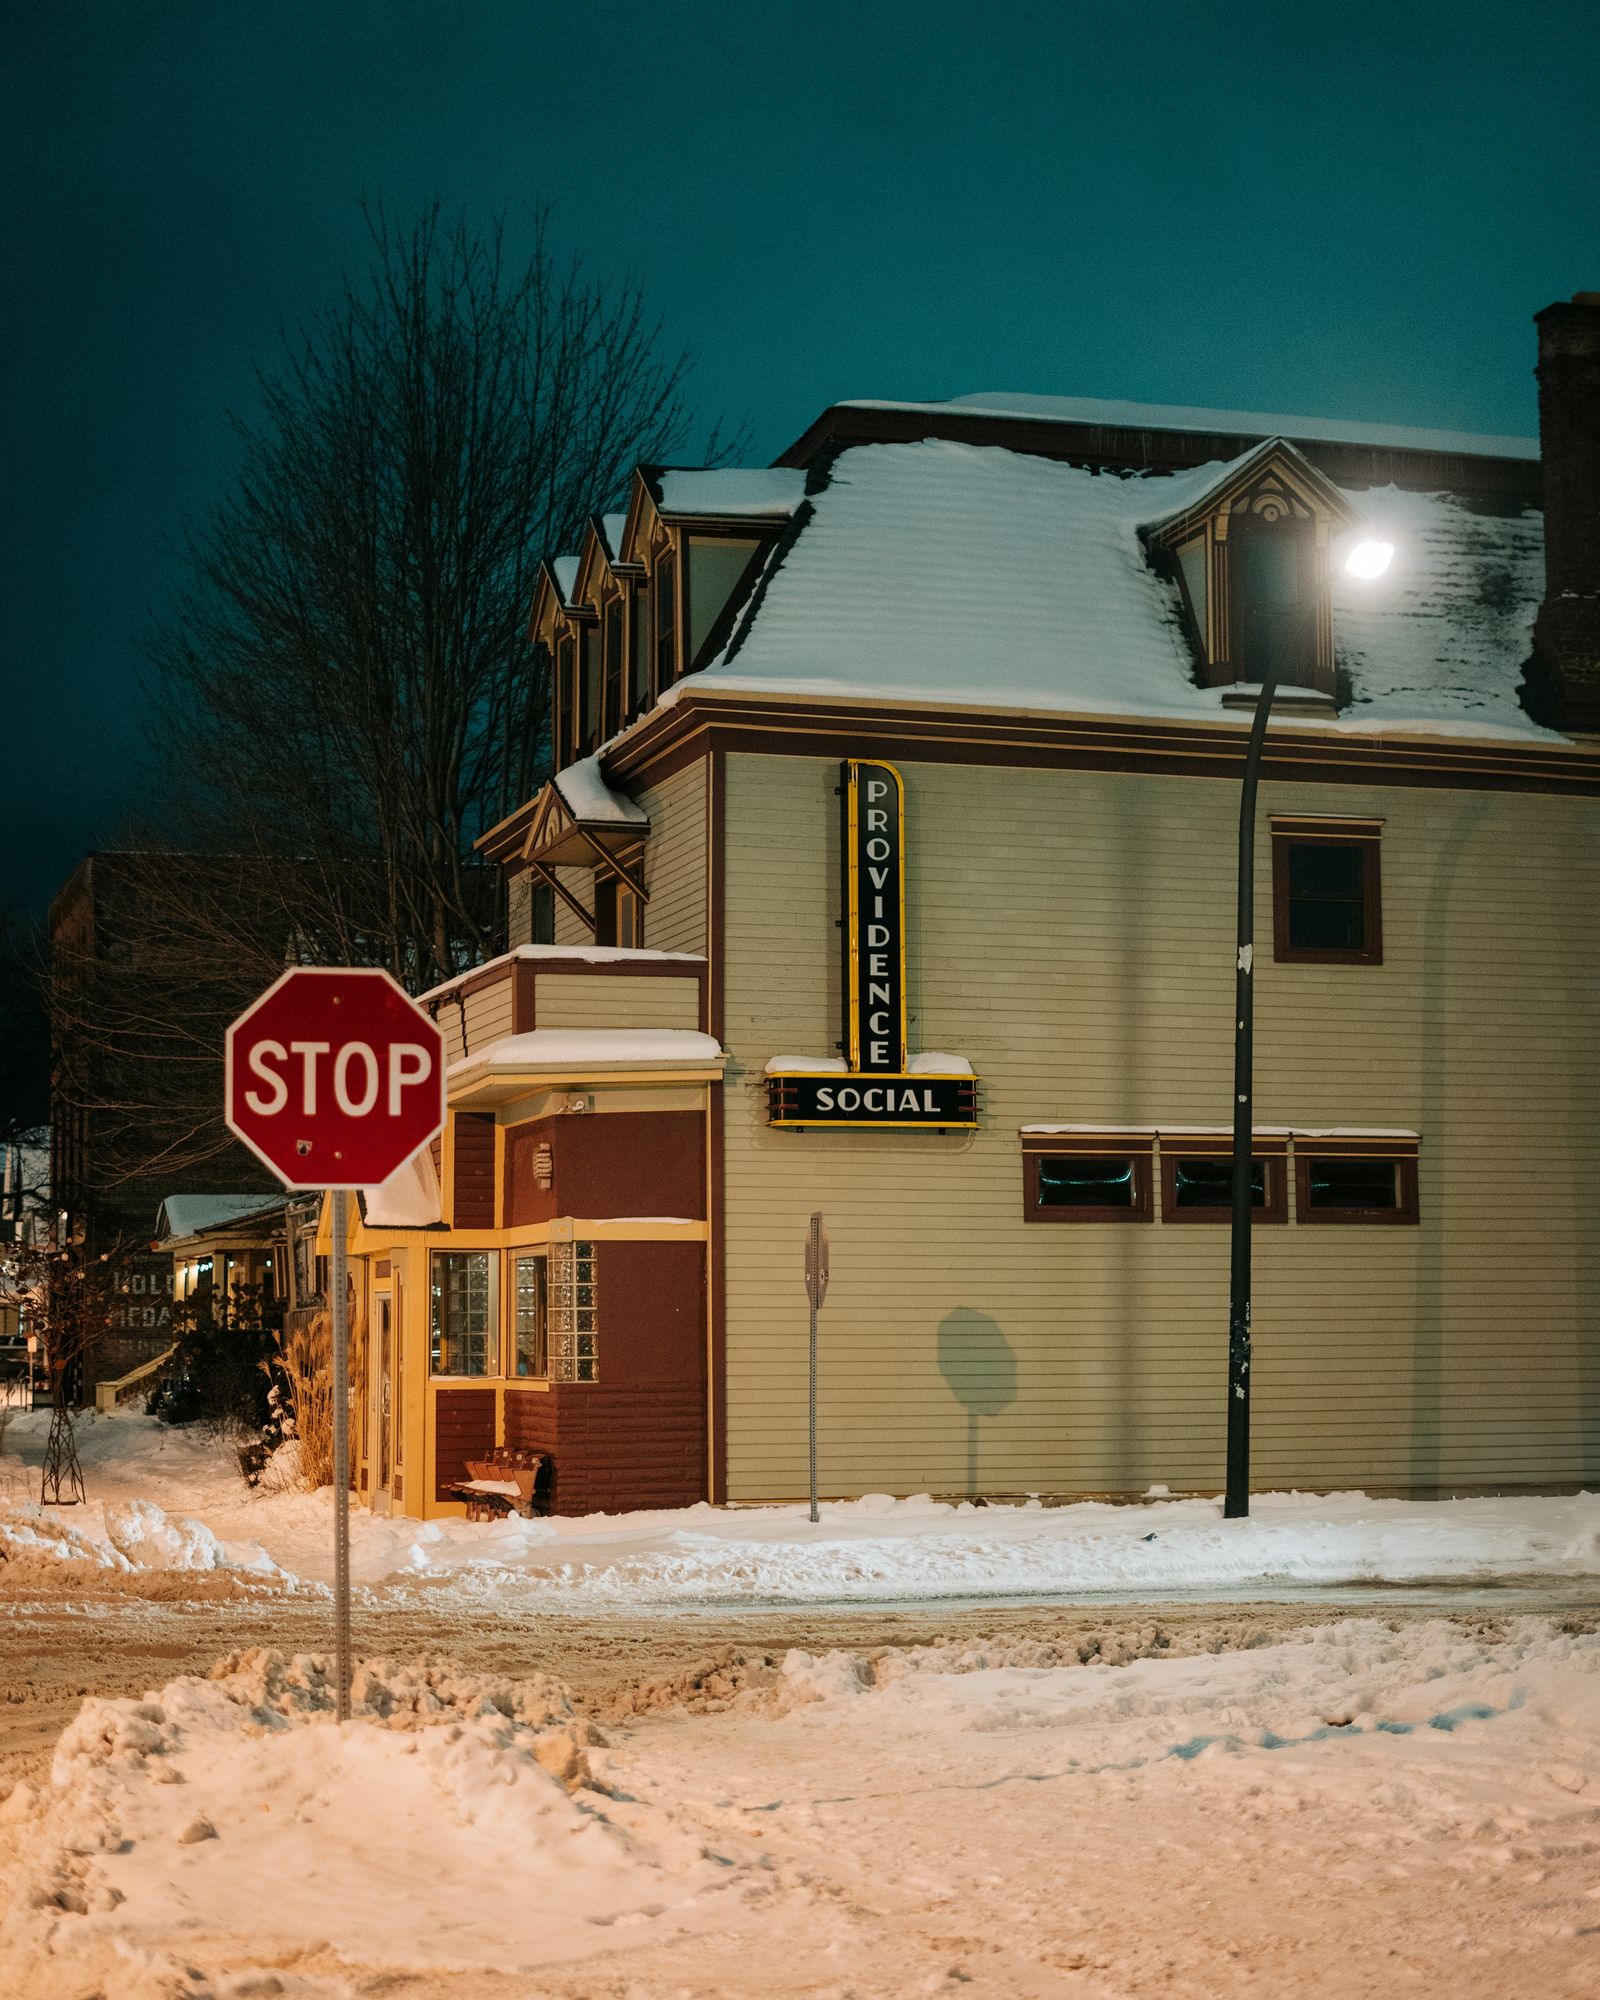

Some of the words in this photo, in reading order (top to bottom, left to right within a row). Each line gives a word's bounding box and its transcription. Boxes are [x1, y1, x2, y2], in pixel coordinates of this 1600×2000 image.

[866, 780, 891, 1064] PROVIDENCE
[244, 1040, 432, 1117] STOP
[816, 1087, 942, 1113] SOCIAL
